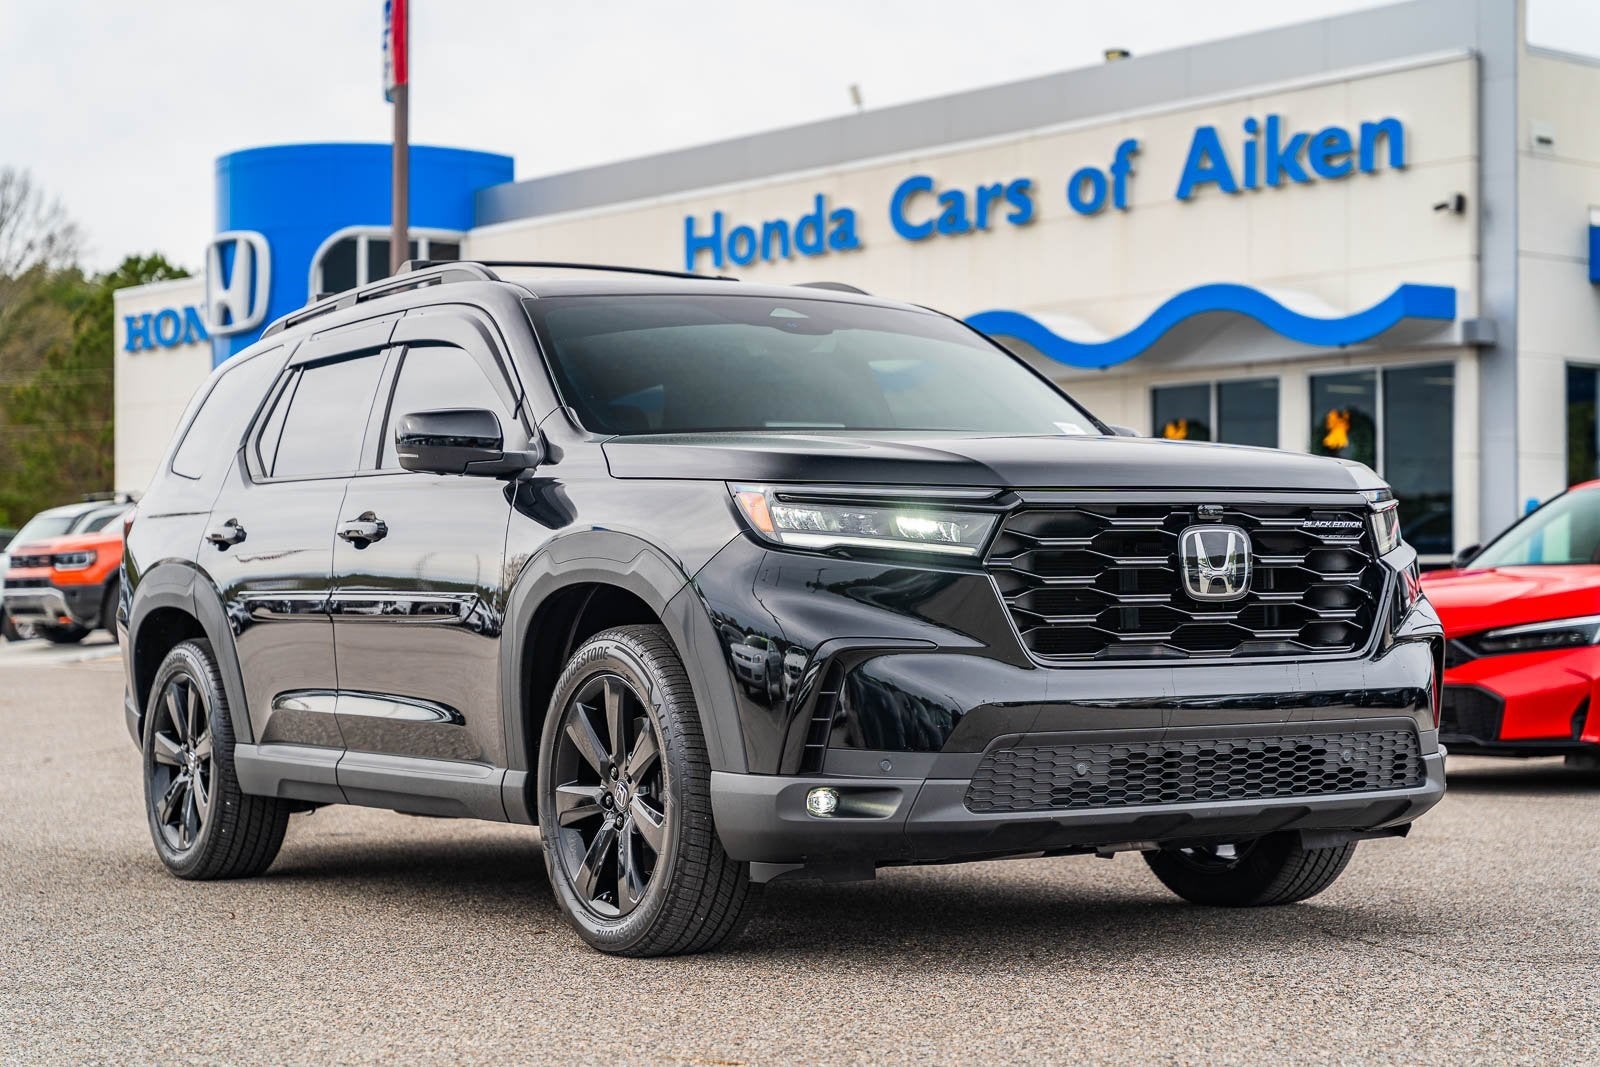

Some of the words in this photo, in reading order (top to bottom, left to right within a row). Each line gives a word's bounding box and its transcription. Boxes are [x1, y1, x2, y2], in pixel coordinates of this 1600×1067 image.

[684, 193, 860, 271] Honda
[889, 175, 1034, 241] Cars
[1067, 138, 1139, 215] of
[1175, 114, 1406, 201] Aiken
[1303, 520, 1331, 528] BLACK
[1332, 520, 1362, 529] EDITION
